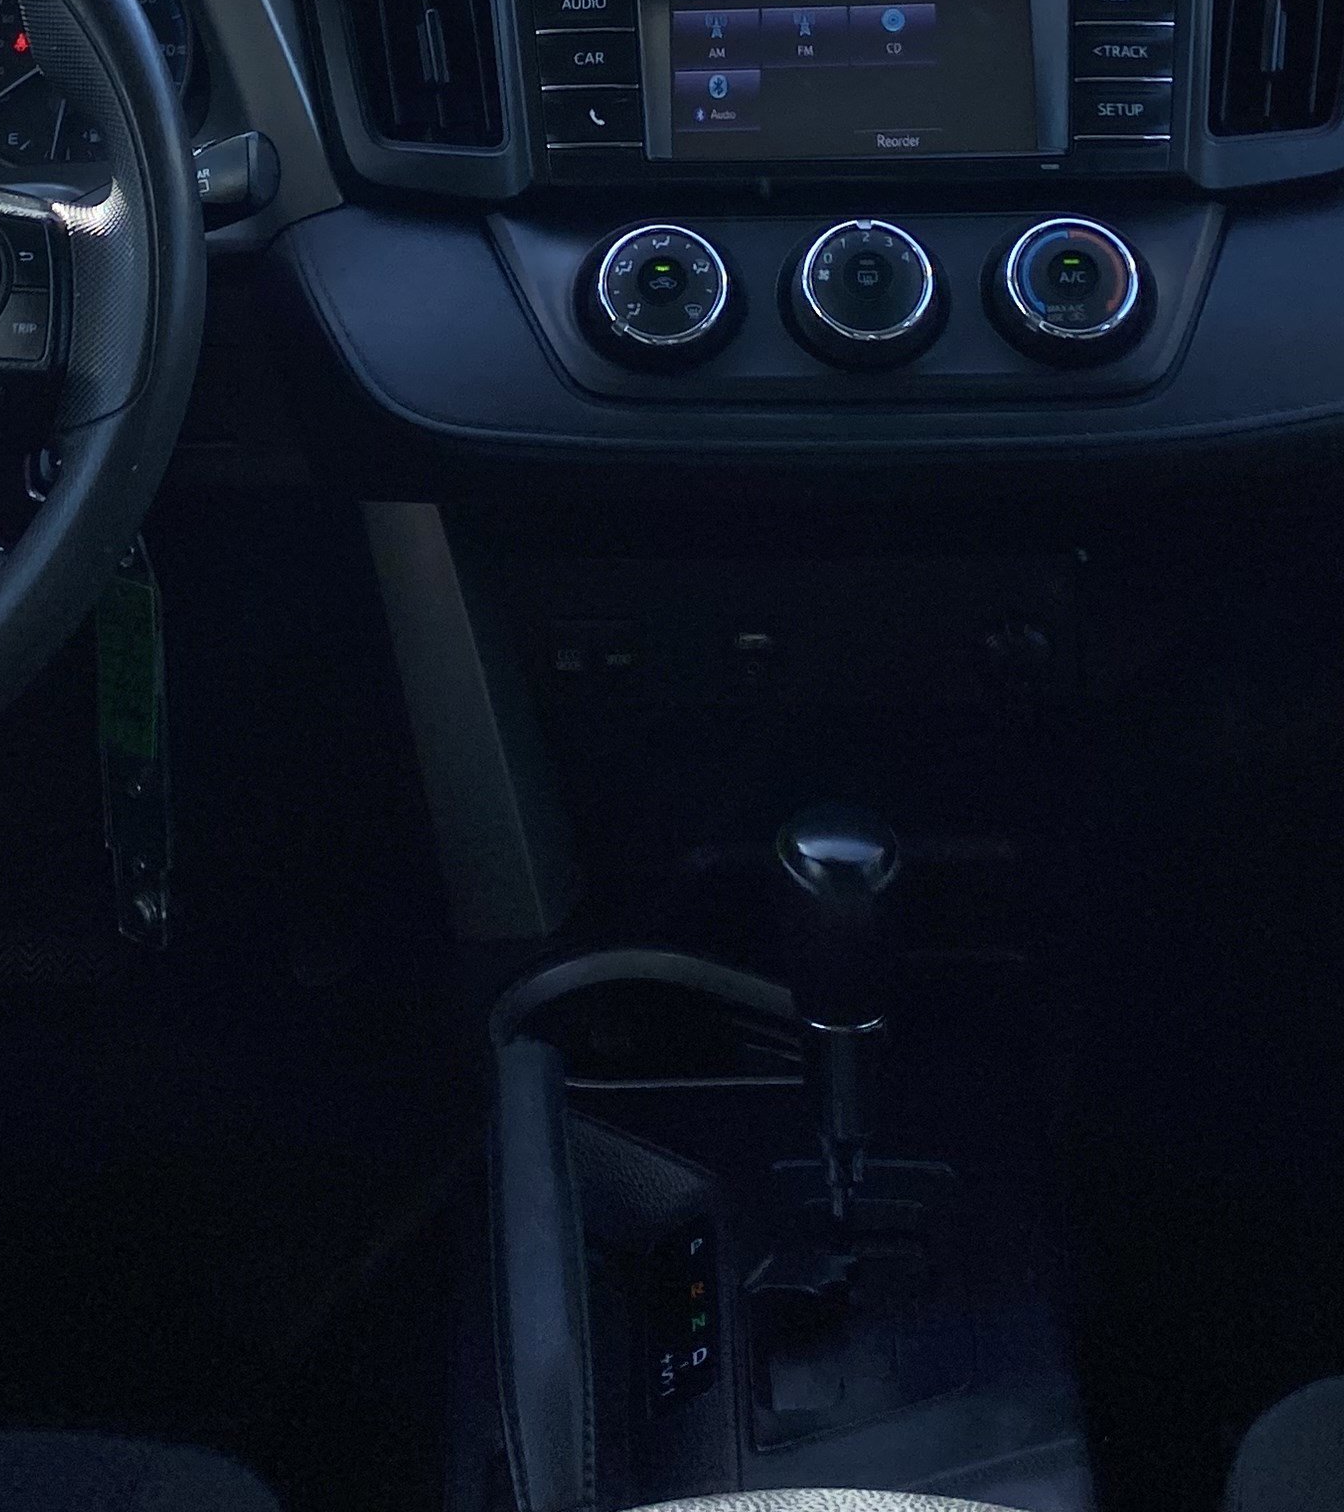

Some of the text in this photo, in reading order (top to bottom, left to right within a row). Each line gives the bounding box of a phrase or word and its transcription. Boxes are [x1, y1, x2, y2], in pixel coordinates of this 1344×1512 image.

[708, 47, 726, 59] AM
[796, 44, 814, 57] FM
[886, 42, 903, 54] CD
[573, 51, 605, 67] CAR
[710, 108, 736, 120] Audio
[1097, 102, 1145, 117] SETUP
[7, 132, 20, 145] E
[876, 134, 920, 147] Reorder
[862, 232, 871, 243] 2
[884, 237, 894, 248] 3
[823, 252, 833, 264] 0
[901, 251, 912, 264] 4
[1059, 271, 1087, 285] A/C
[11, 322, 38, 335] TRIP
[690, 1237, 704, 1256] P
[691, 1312, 707, 1332] N
[692, 1346, 708, 1367] D
[660, 1364, 674, 1384] S
